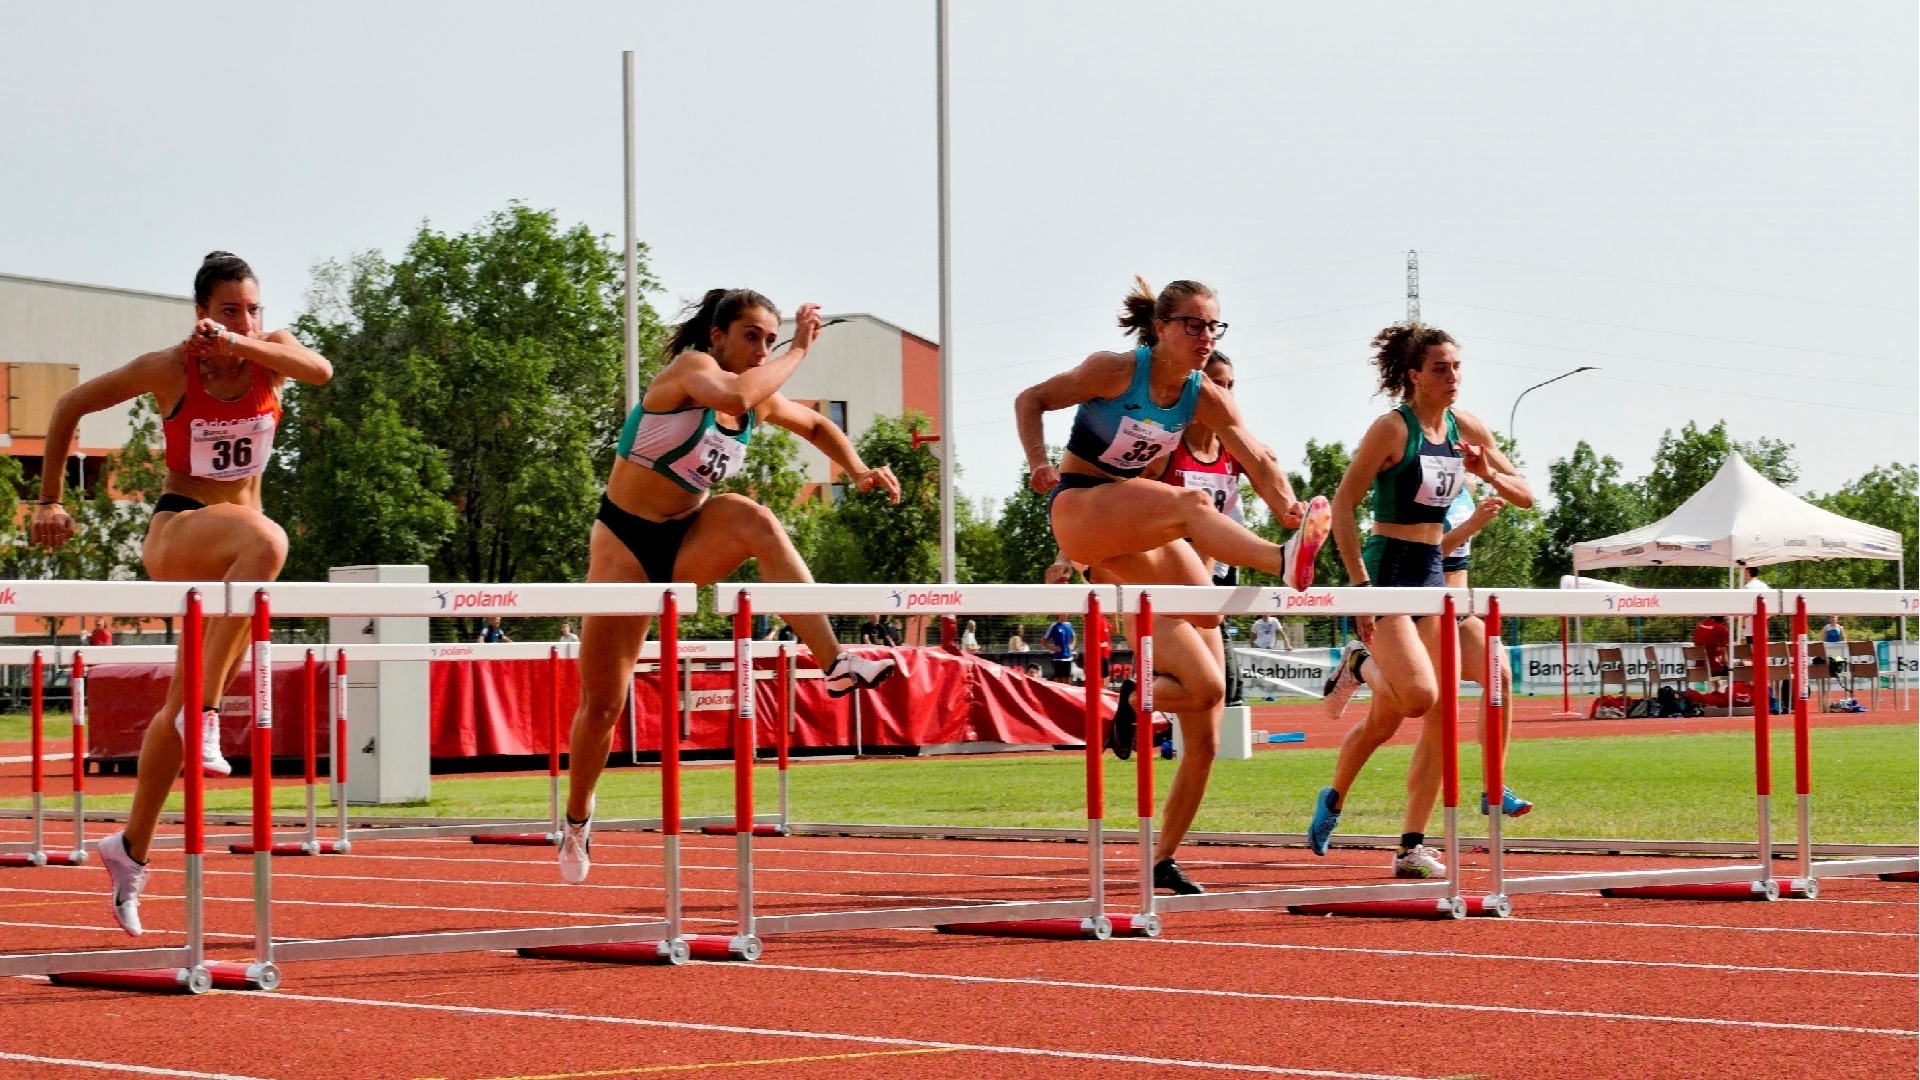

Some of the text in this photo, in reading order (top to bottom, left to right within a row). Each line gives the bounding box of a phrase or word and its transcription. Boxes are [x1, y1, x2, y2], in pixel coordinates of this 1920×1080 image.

[212, 437, 252, 471] 36
[1122, 440, 1162, 462] 33
[696, 448, 731, 483] 35
[1435, 470, 1456, 497] 37
[453, 590, 519, 611] polanik
[906, 590, 963, 610] polanik
[1286, 592, 1336, 610] polanik
[1617, 594, 1660, 612] polanik
[439, 646, 474, 657] polanik
[1239, 663, 1323, 679] alsabbina
[259, 664, 270, 712] polanik
[742, 660, 751, 704] polanik
[696, 693, 735, 708] polani
